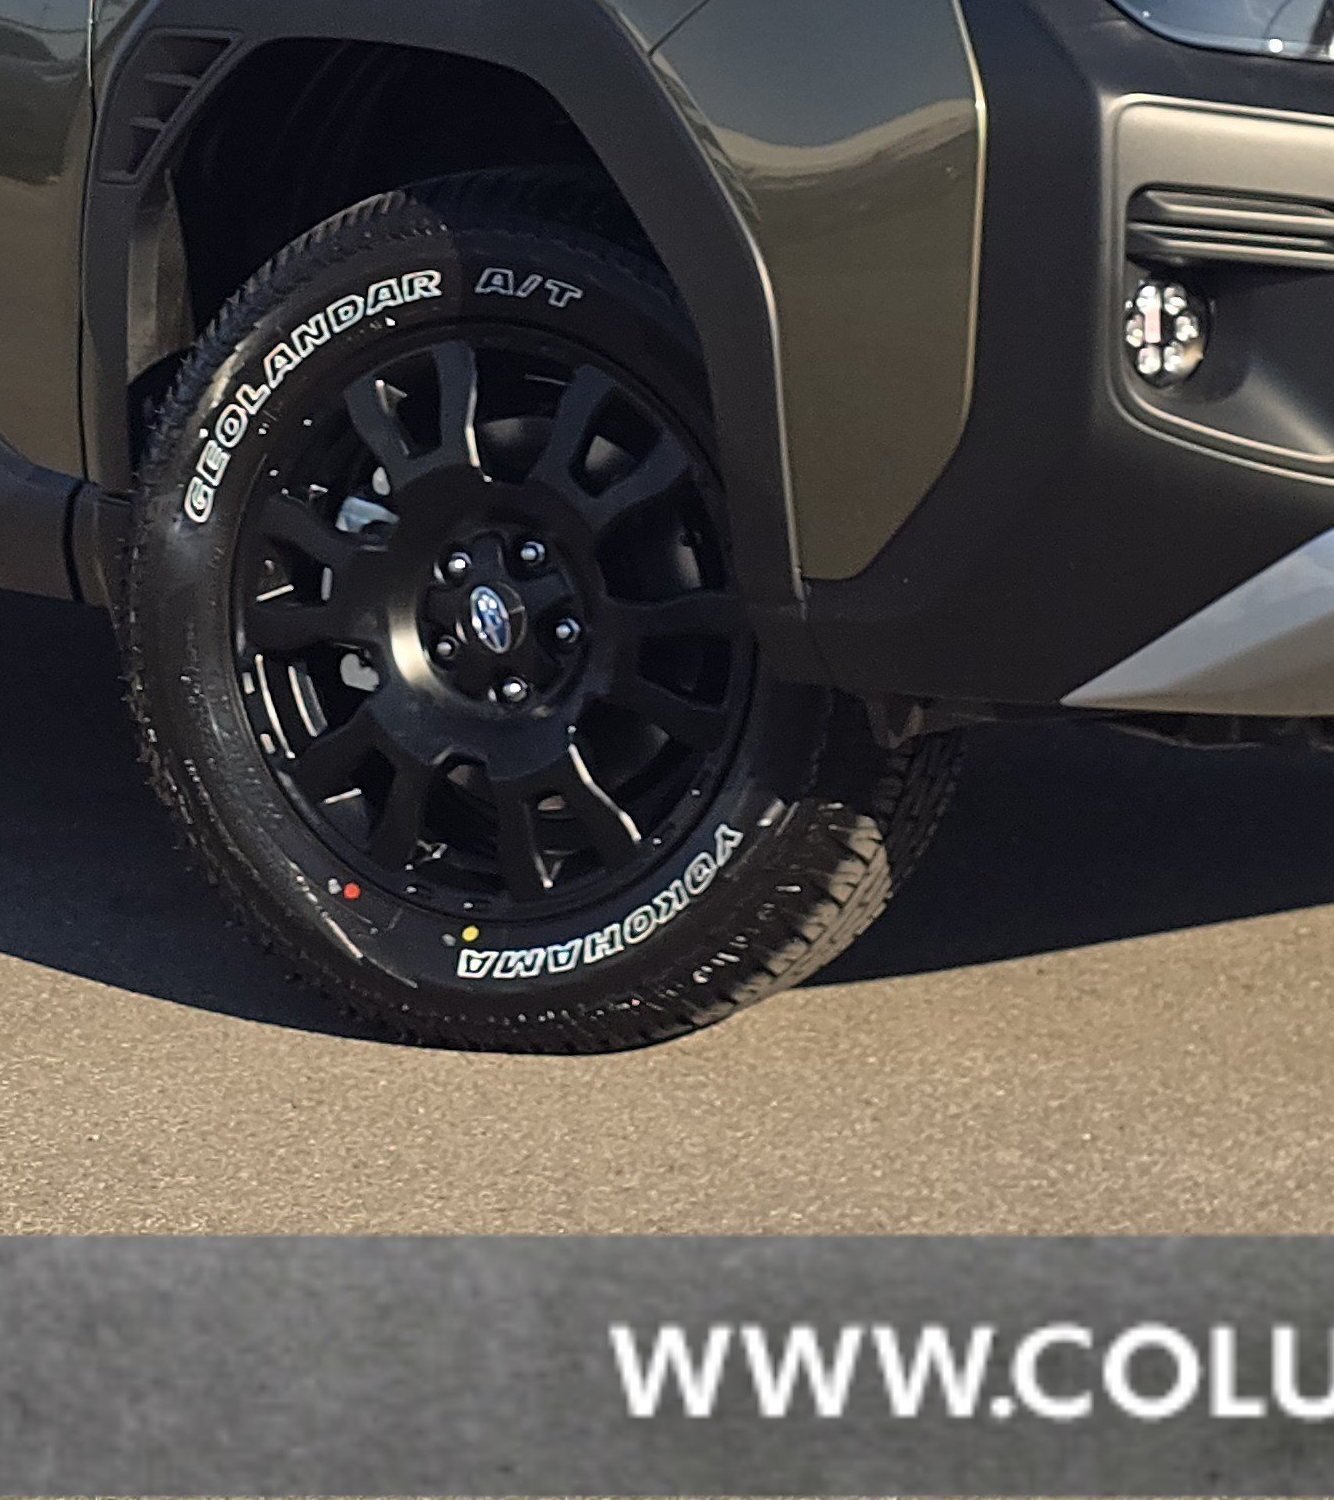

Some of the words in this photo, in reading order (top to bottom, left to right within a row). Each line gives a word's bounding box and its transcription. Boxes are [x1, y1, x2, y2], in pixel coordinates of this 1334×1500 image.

[183, 269, 442, 524] GEOLANDAR
[474, 267, 583, 309] A/T
[457, 823, 744, 979] YOKOHAMA
